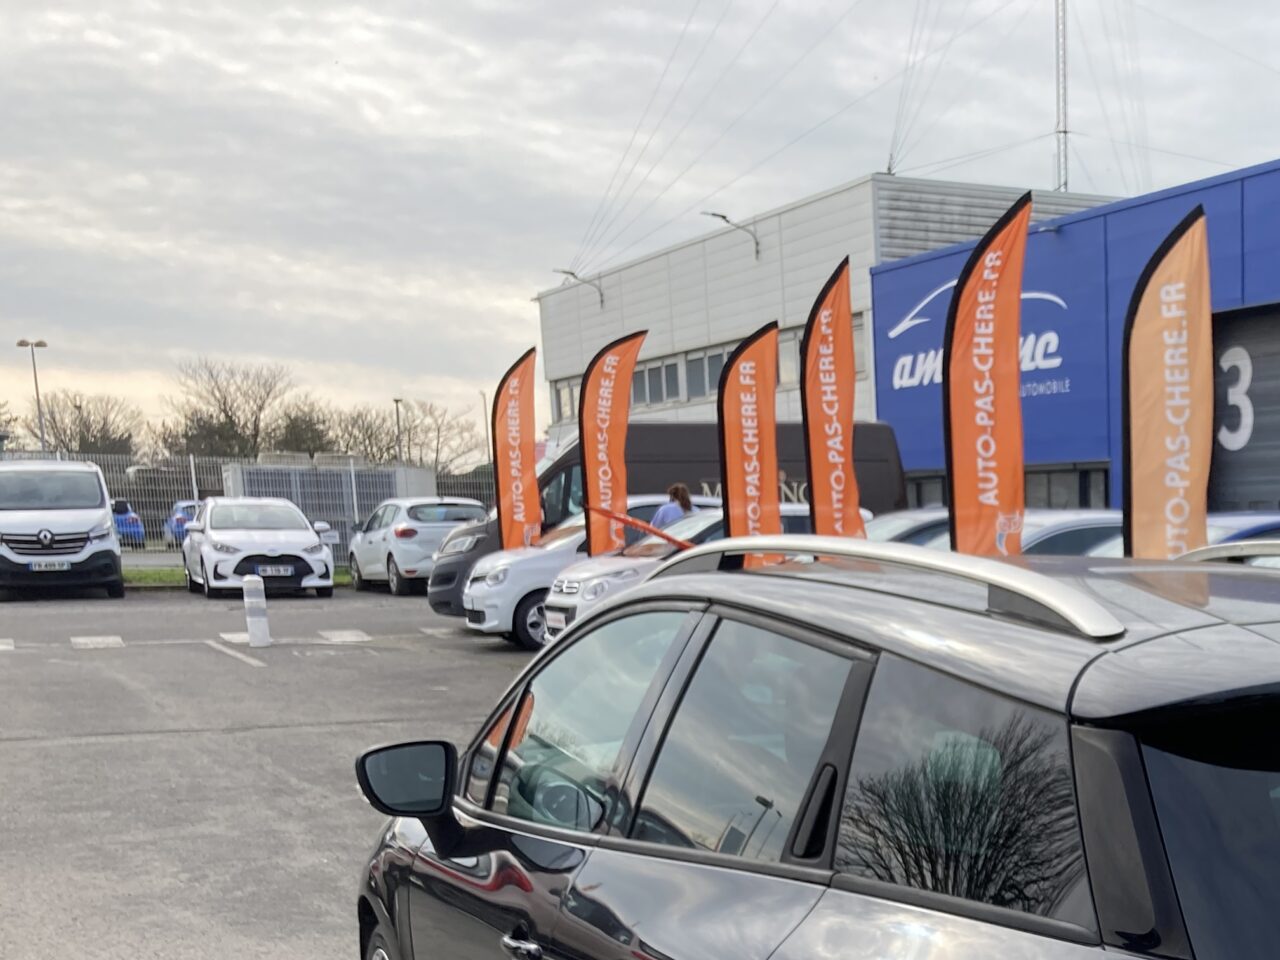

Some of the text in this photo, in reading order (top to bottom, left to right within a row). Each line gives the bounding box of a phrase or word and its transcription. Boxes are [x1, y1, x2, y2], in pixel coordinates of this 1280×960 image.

[508, 378, 526, 522] AUTO-PAS-CHERE.FR
[597, 355, 620, 511] AUTO-PAS-CHERE.FR
[973, 250, 1003, 506] AUTO-PAS-CHERE.FR
[1160, 282, 1191, 560] UTO-PAS-CHERE.FR
[1218, 347, 1254, 451] 3
